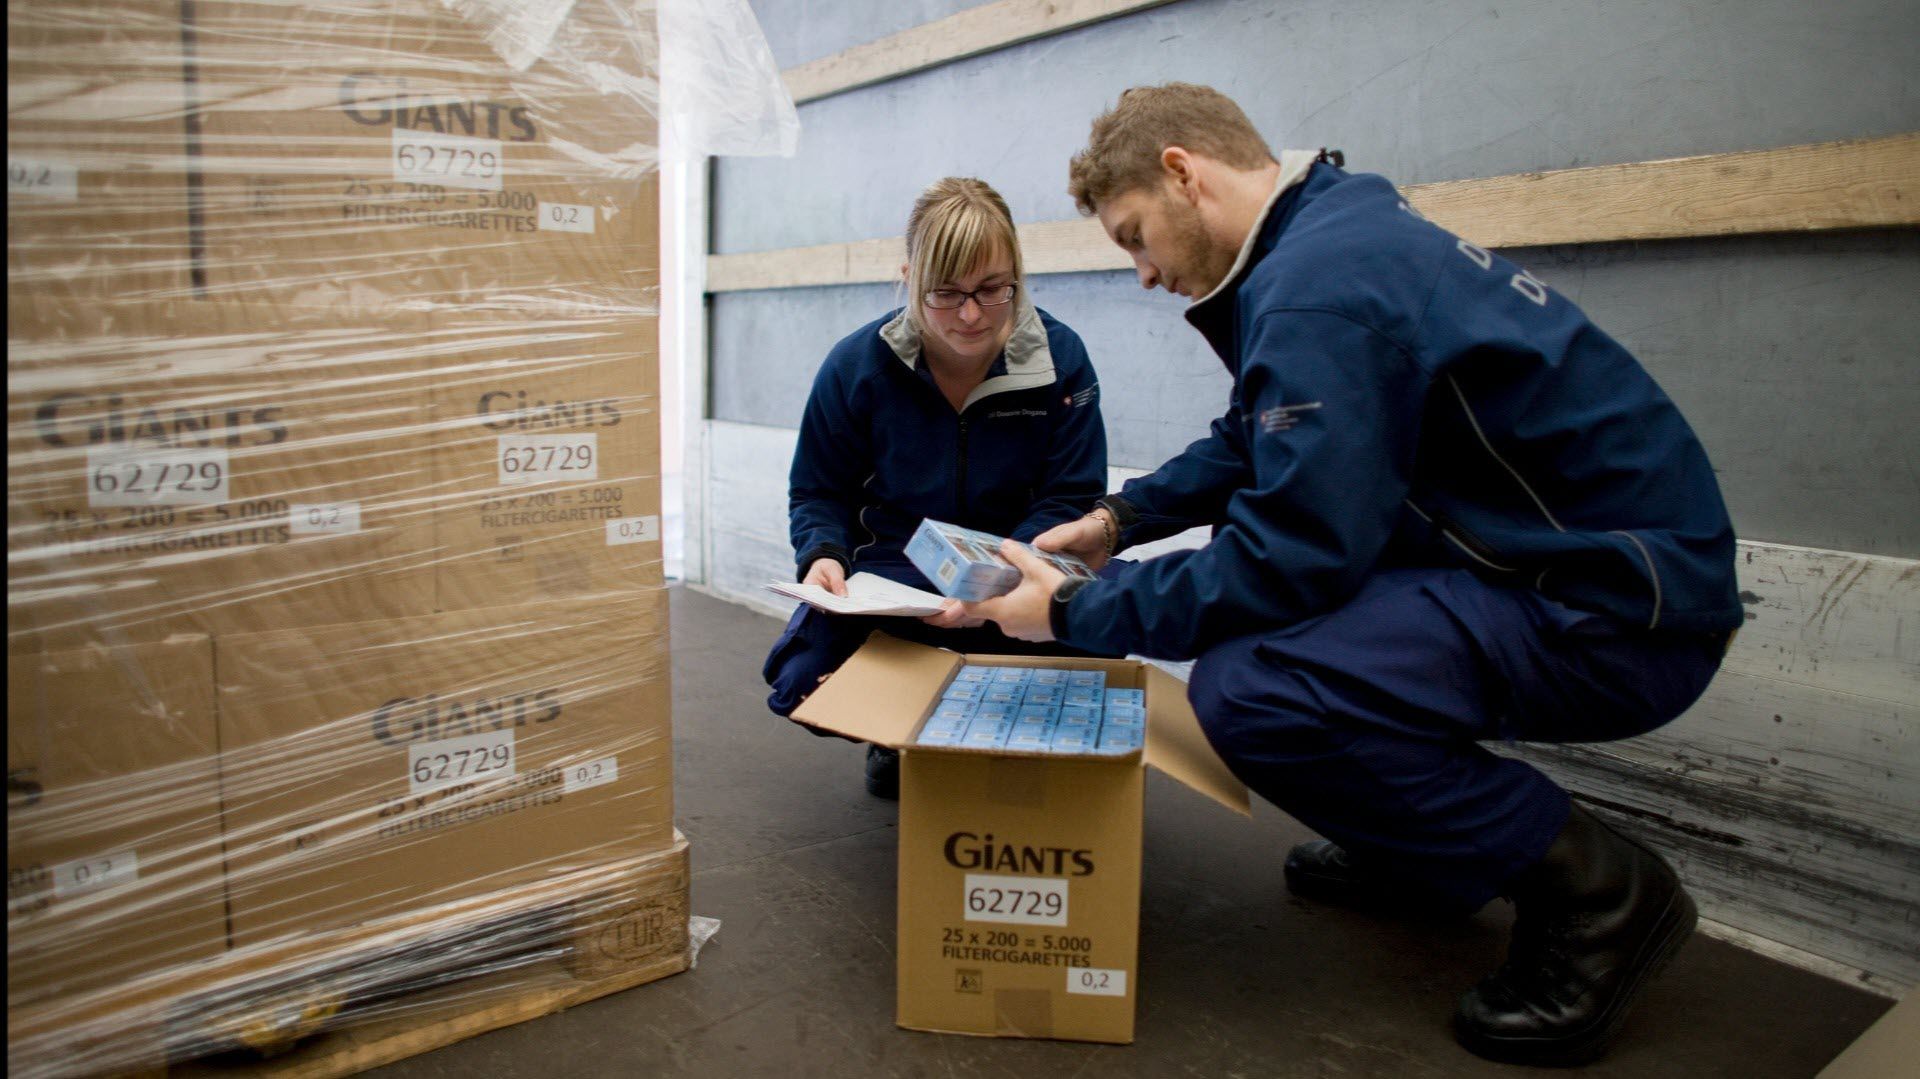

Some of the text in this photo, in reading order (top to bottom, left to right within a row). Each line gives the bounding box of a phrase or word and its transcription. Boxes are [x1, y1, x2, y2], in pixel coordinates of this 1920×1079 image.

[397, 144, 497, 178] 62729
[477, 190, 537, 212] 5.000
[551, 206, 579, 225] 0,2
[502, 445, 592, 473] 62729
[94, 461, 222, 494] 62729
[579, 487, 624, 504] 5.000
[215, 499, 289, 522] 5000
[308, 507, 340, 527] 0,2
[481, 505, 624, 529] FILTERCIGARETTES
[619, 521, 644, 537] 0,2
[413, 744, 510, 783] 62729
[577, 763, 603, 783] 0,2
[944, 832, 1095, 877] GiANTS
[968, 888, 1063, 917] 62729
[943, 927, 964, 944] 25
[986, 931, 1018, 948] 200
[1043, 935, 1092, 952] 5.000
[943, 946, 1091, 968] FILTERCIGARETTES
[1081, 972, 1110, 989] 0,2
